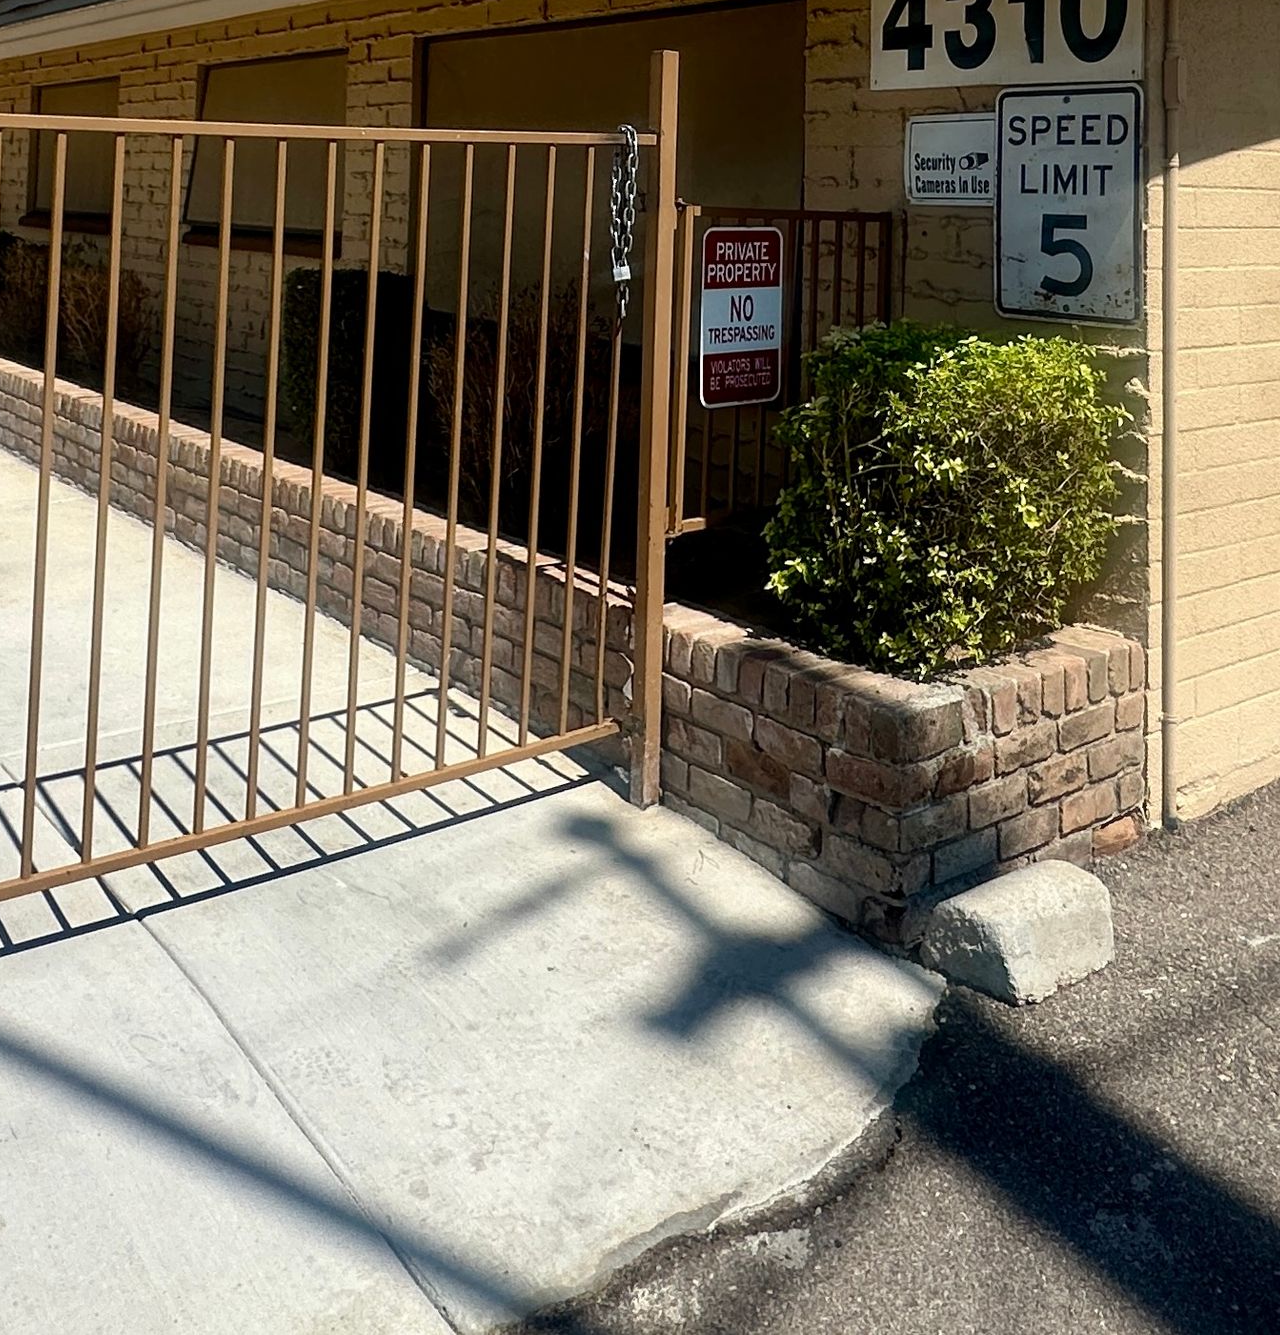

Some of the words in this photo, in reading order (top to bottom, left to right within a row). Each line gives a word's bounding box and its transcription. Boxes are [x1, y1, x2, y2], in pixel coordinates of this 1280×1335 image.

[1008, 114, 1129, 146] SPEED
[914, 152, 956, 175] Security
[915, 175, 956, 194] Cameras
[959, 175, 968, 194] In
[971, 175, 990, 194] Use
[1021, 164, 1113, 196] LIMIT
[716, 242, 769, 261] PRIVATE
[1040, 214, 1093, 297] 5
[707, 263, 776, 284] PROPERTY
[730, 295, 754, 323] NO
[708, 325, 775, 344] TRESPASSING
[710, 358, 751, 374] VIOLATORS
[754, 357, 772, 370] WILL
[710, 376, 721, 391] BE
[724, 372, 771, 389] PROSECUTED
